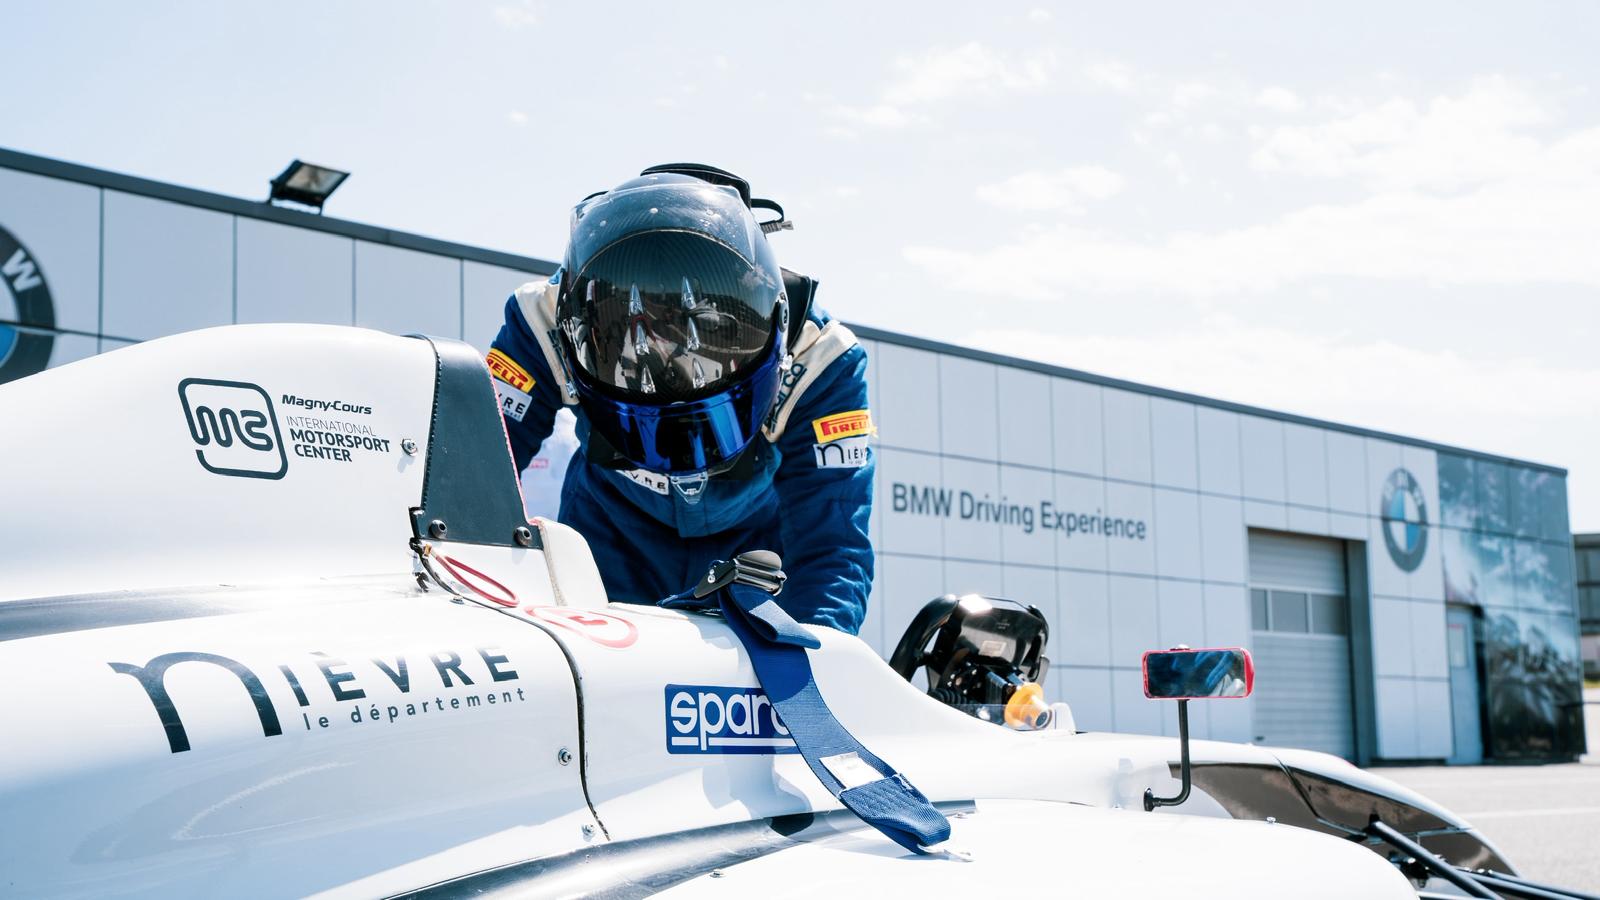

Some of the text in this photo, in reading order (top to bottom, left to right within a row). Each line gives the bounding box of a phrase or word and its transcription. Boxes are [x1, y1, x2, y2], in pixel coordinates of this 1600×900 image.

[282, 395, 372, 415] Magny-Cours
[499, 393, 526, 415] RE
[286, 416, 376, 436] INTERNATIONAL
[289, 429, 390, 452] MOTORSPORT
[295, 444, 352, 462] CENTER
[892, 483, 1146, 540] BMW Driving Experience
[303, 688, 526, 730] le département
